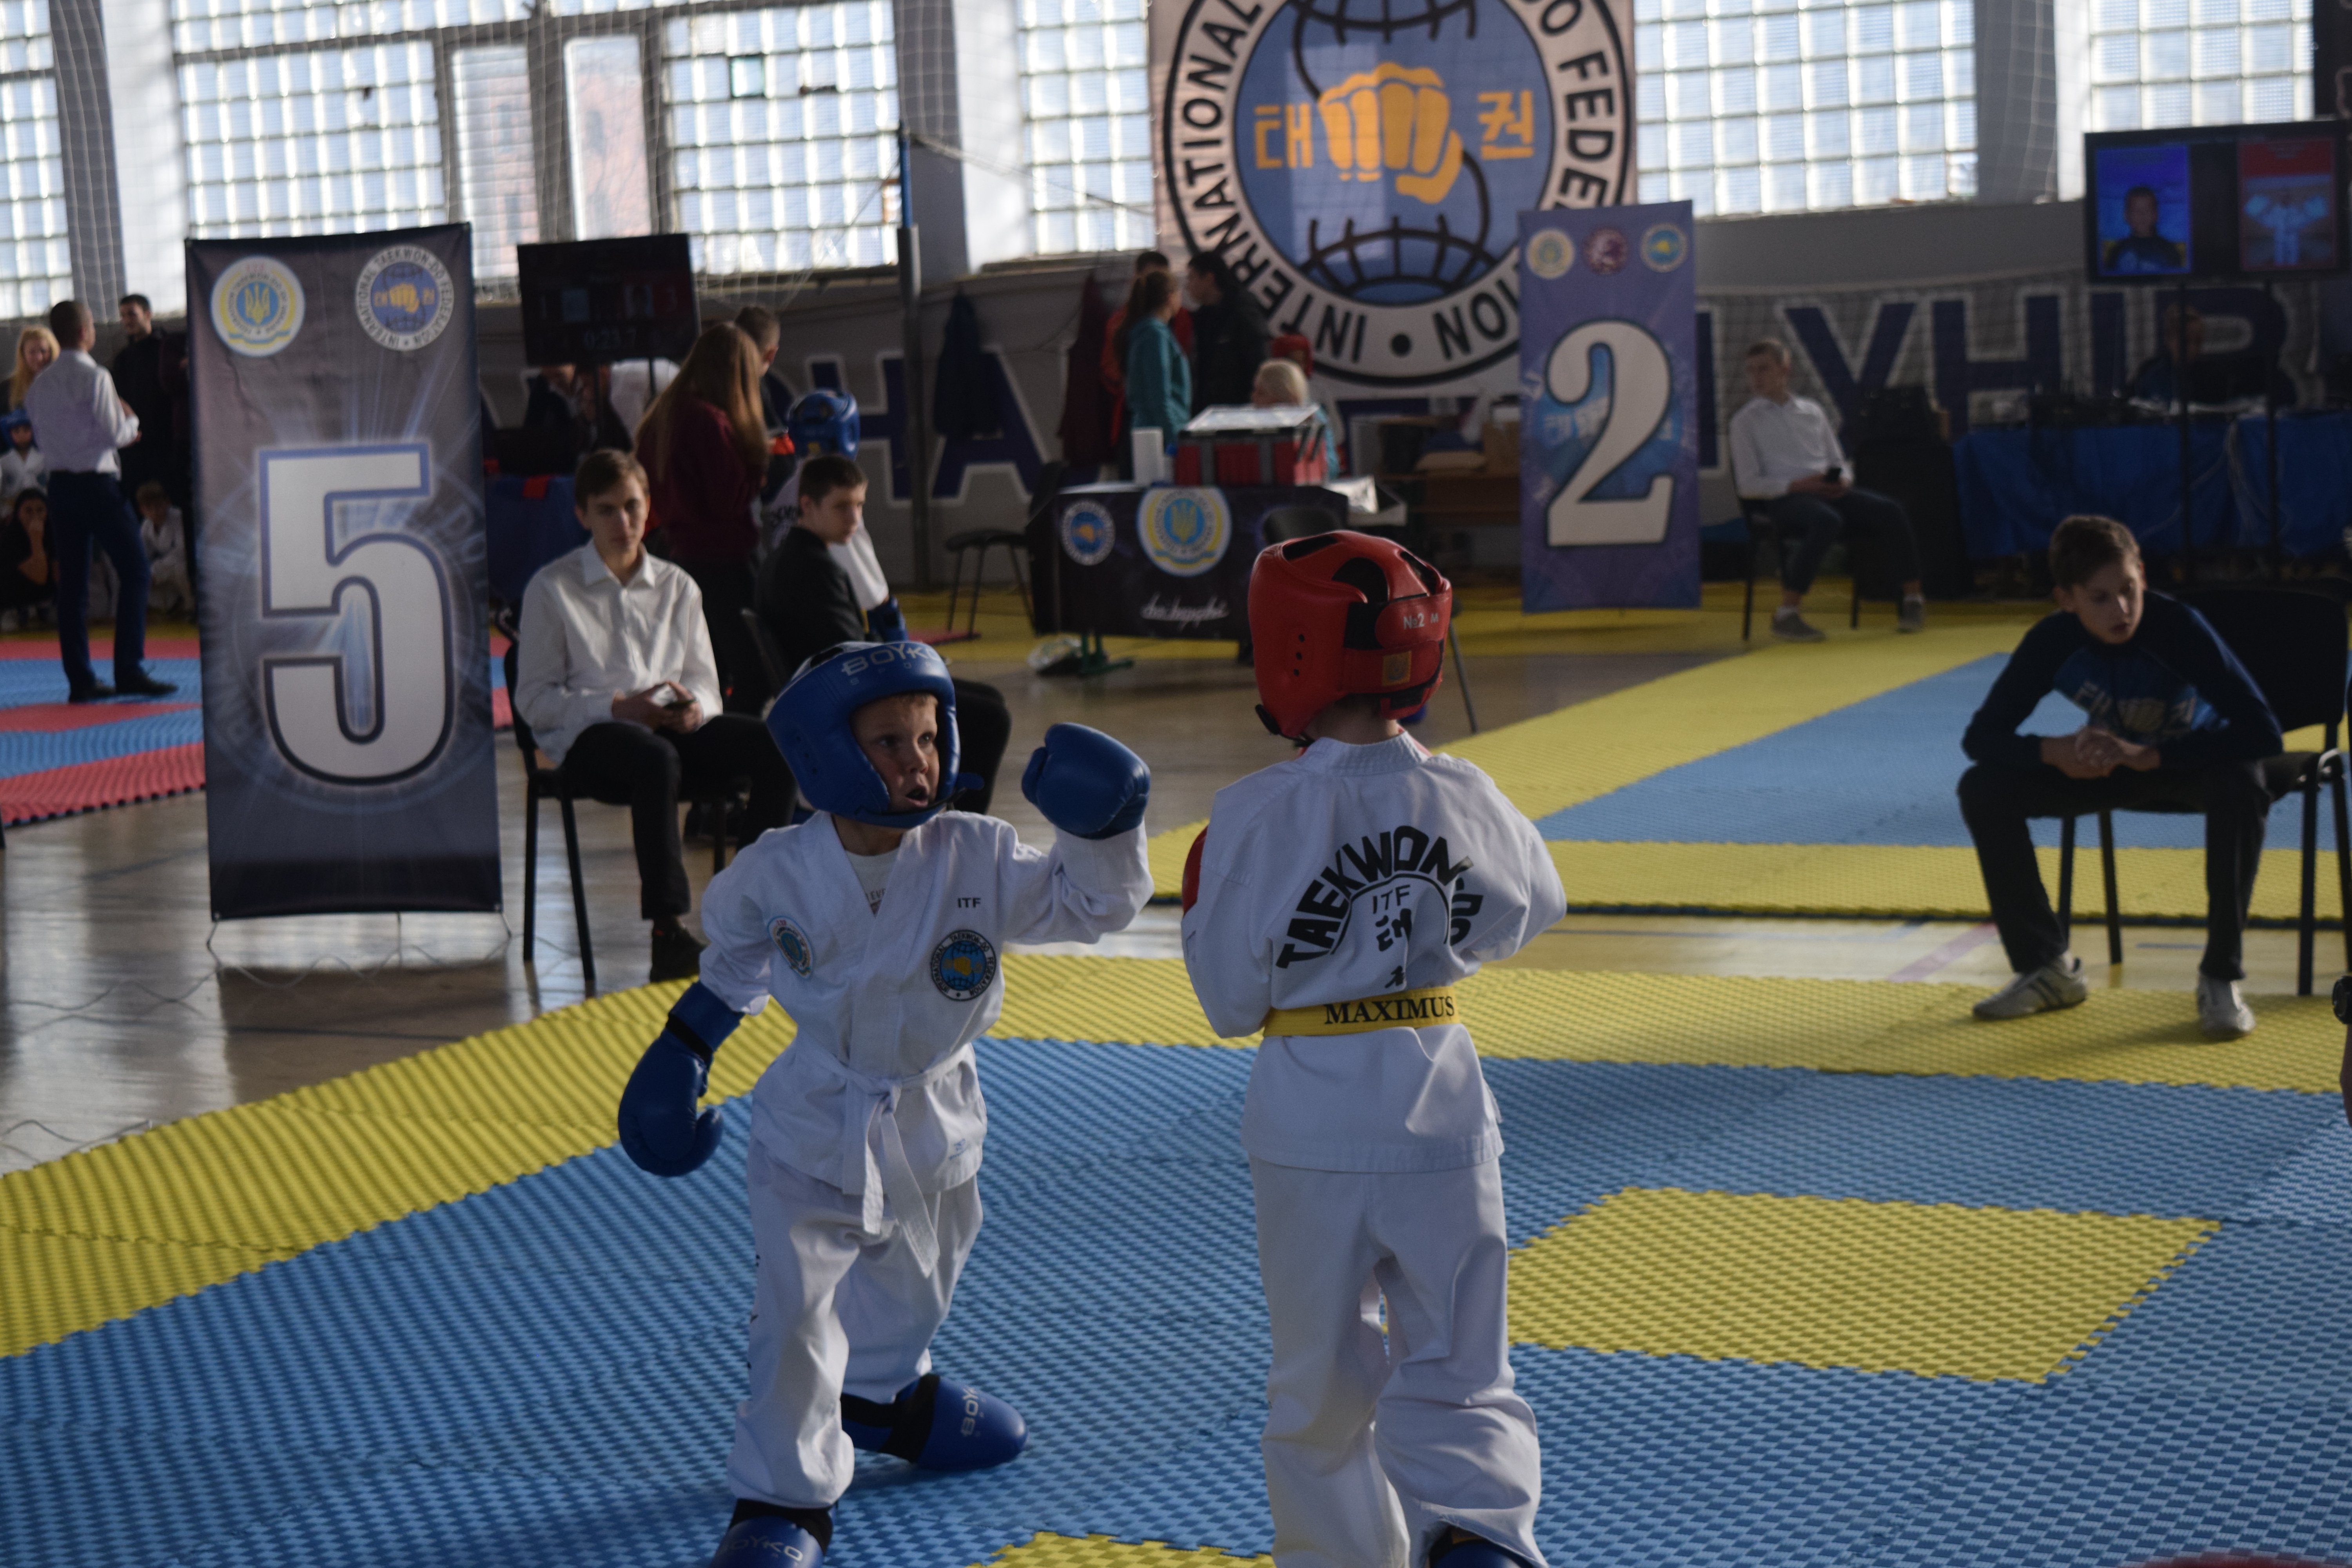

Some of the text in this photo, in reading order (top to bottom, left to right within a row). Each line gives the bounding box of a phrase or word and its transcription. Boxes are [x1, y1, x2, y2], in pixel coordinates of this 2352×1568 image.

[1181, 0, 1367, 363] INTERNATIONAL
[1546, 319, 1675, 548] 2
[259, 442, 455, 785] 5
[957, 897, 981, 908] ITF
[1373, 884, 1410, 914] ITF
[1324, 995, 1455, 1024] MAXIMUS
